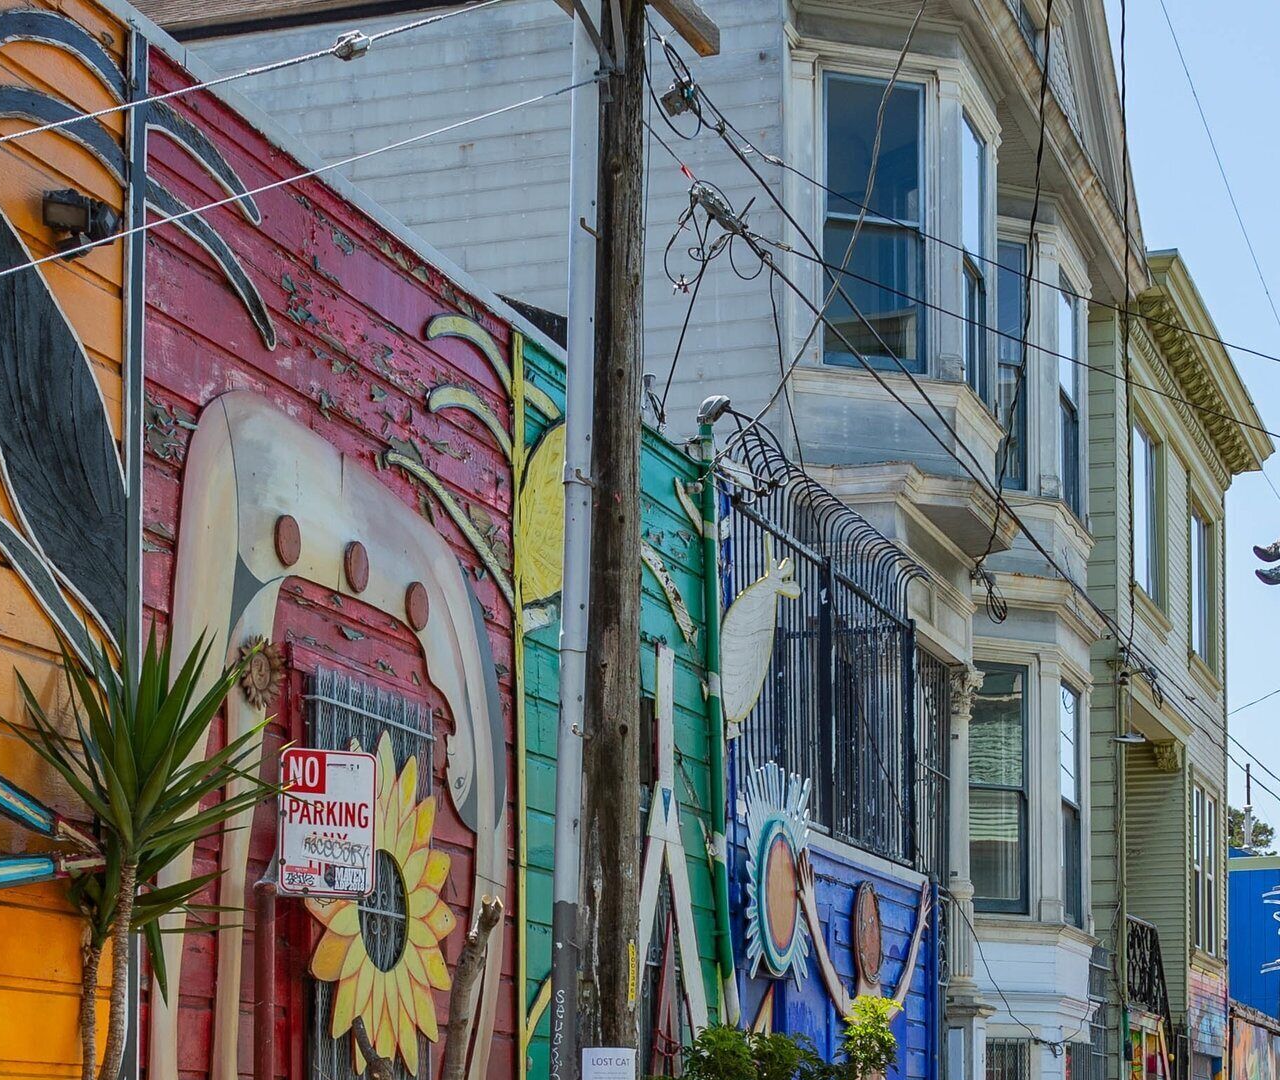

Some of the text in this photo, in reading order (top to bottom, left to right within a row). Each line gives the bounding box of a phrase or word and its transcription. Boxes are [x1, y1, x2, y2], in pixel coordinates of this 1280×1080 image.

[289, 756, 320, 788] NO
[288, 799, 369, 829] PARKING
[592, 1058, 630, 1066] LOST CAT
